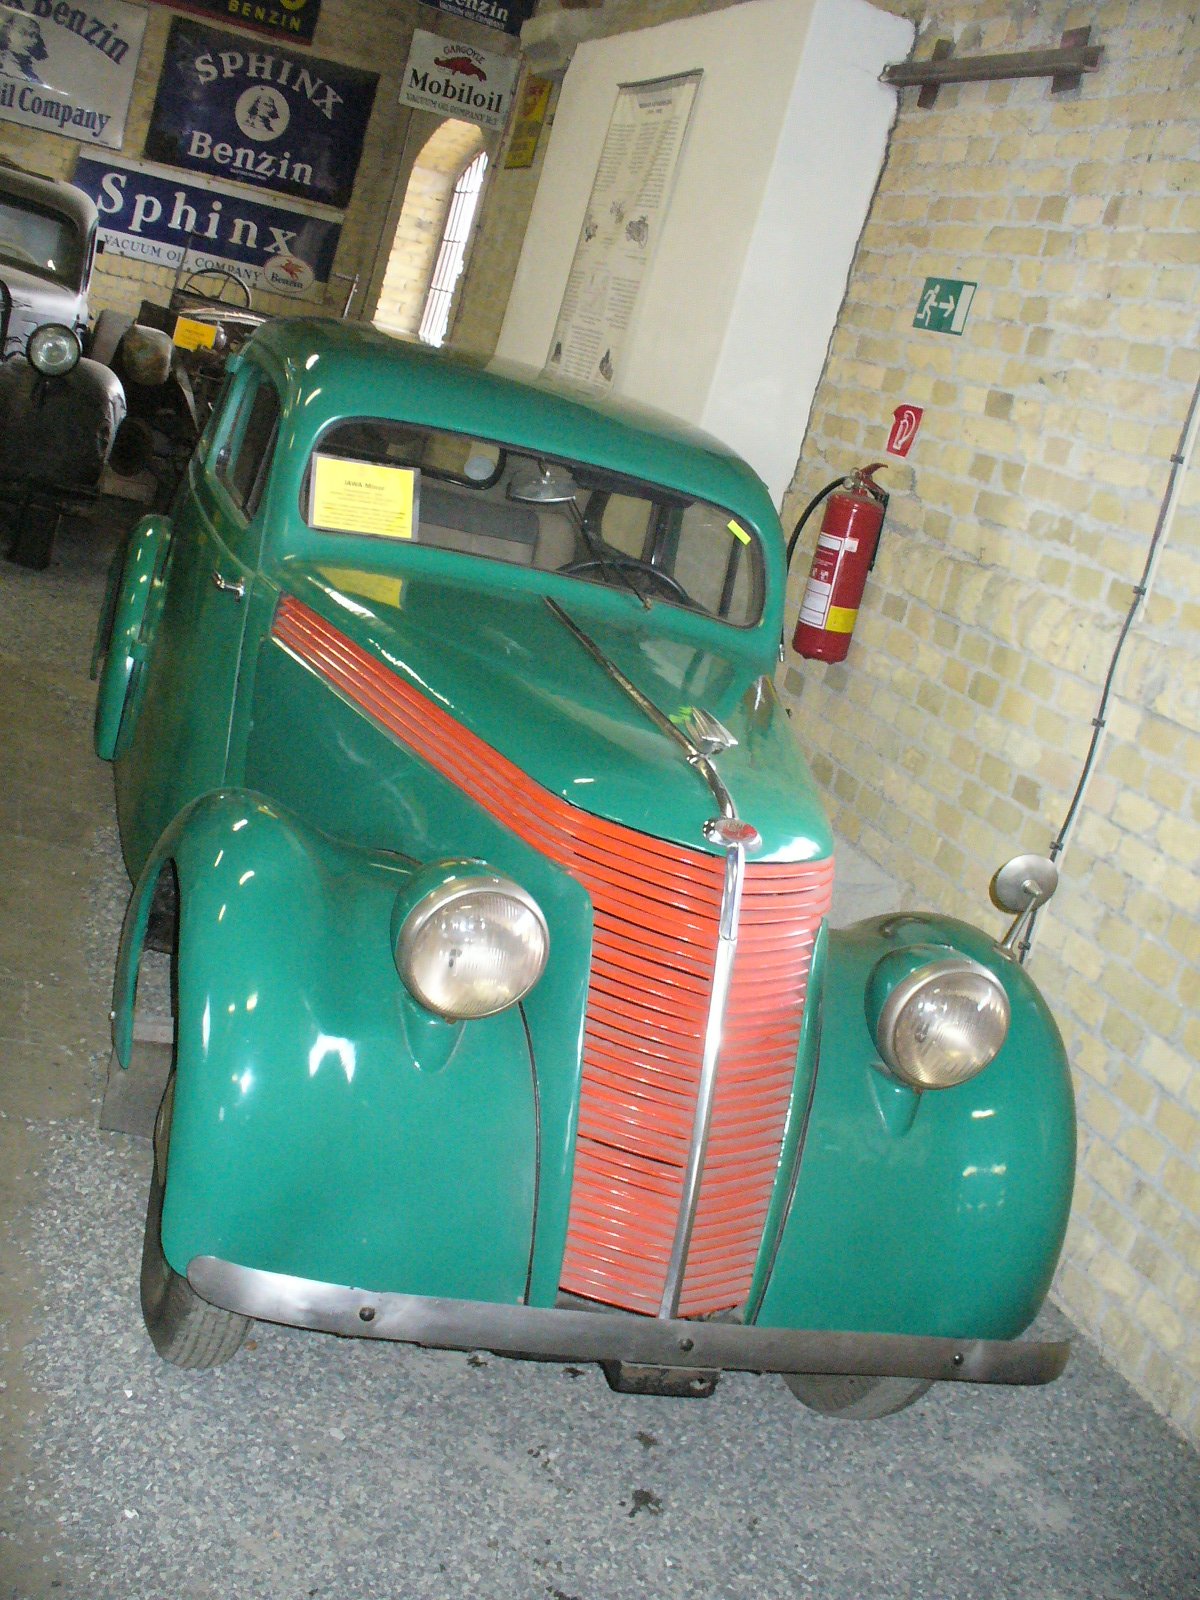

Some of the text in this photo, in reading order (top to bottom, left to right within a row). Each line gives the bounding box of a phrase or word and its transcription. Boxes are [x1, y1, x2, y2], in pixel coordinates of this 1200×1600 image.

[228, 0, 300, 32] BENZIN
[444, 45, 485, 64] GARGOYLE
[194, 51, 344, 120] SPHINX
[407, 68, 504, 114] Mobiloil
[19, 87, 111, 137] Company
[187, 130, 313, 185] Benzin
[97, 173, 297, 256] Sphinx
[104, 234, 162, 258] VACUUM
[195, 257, 264, 282] COMPANY
